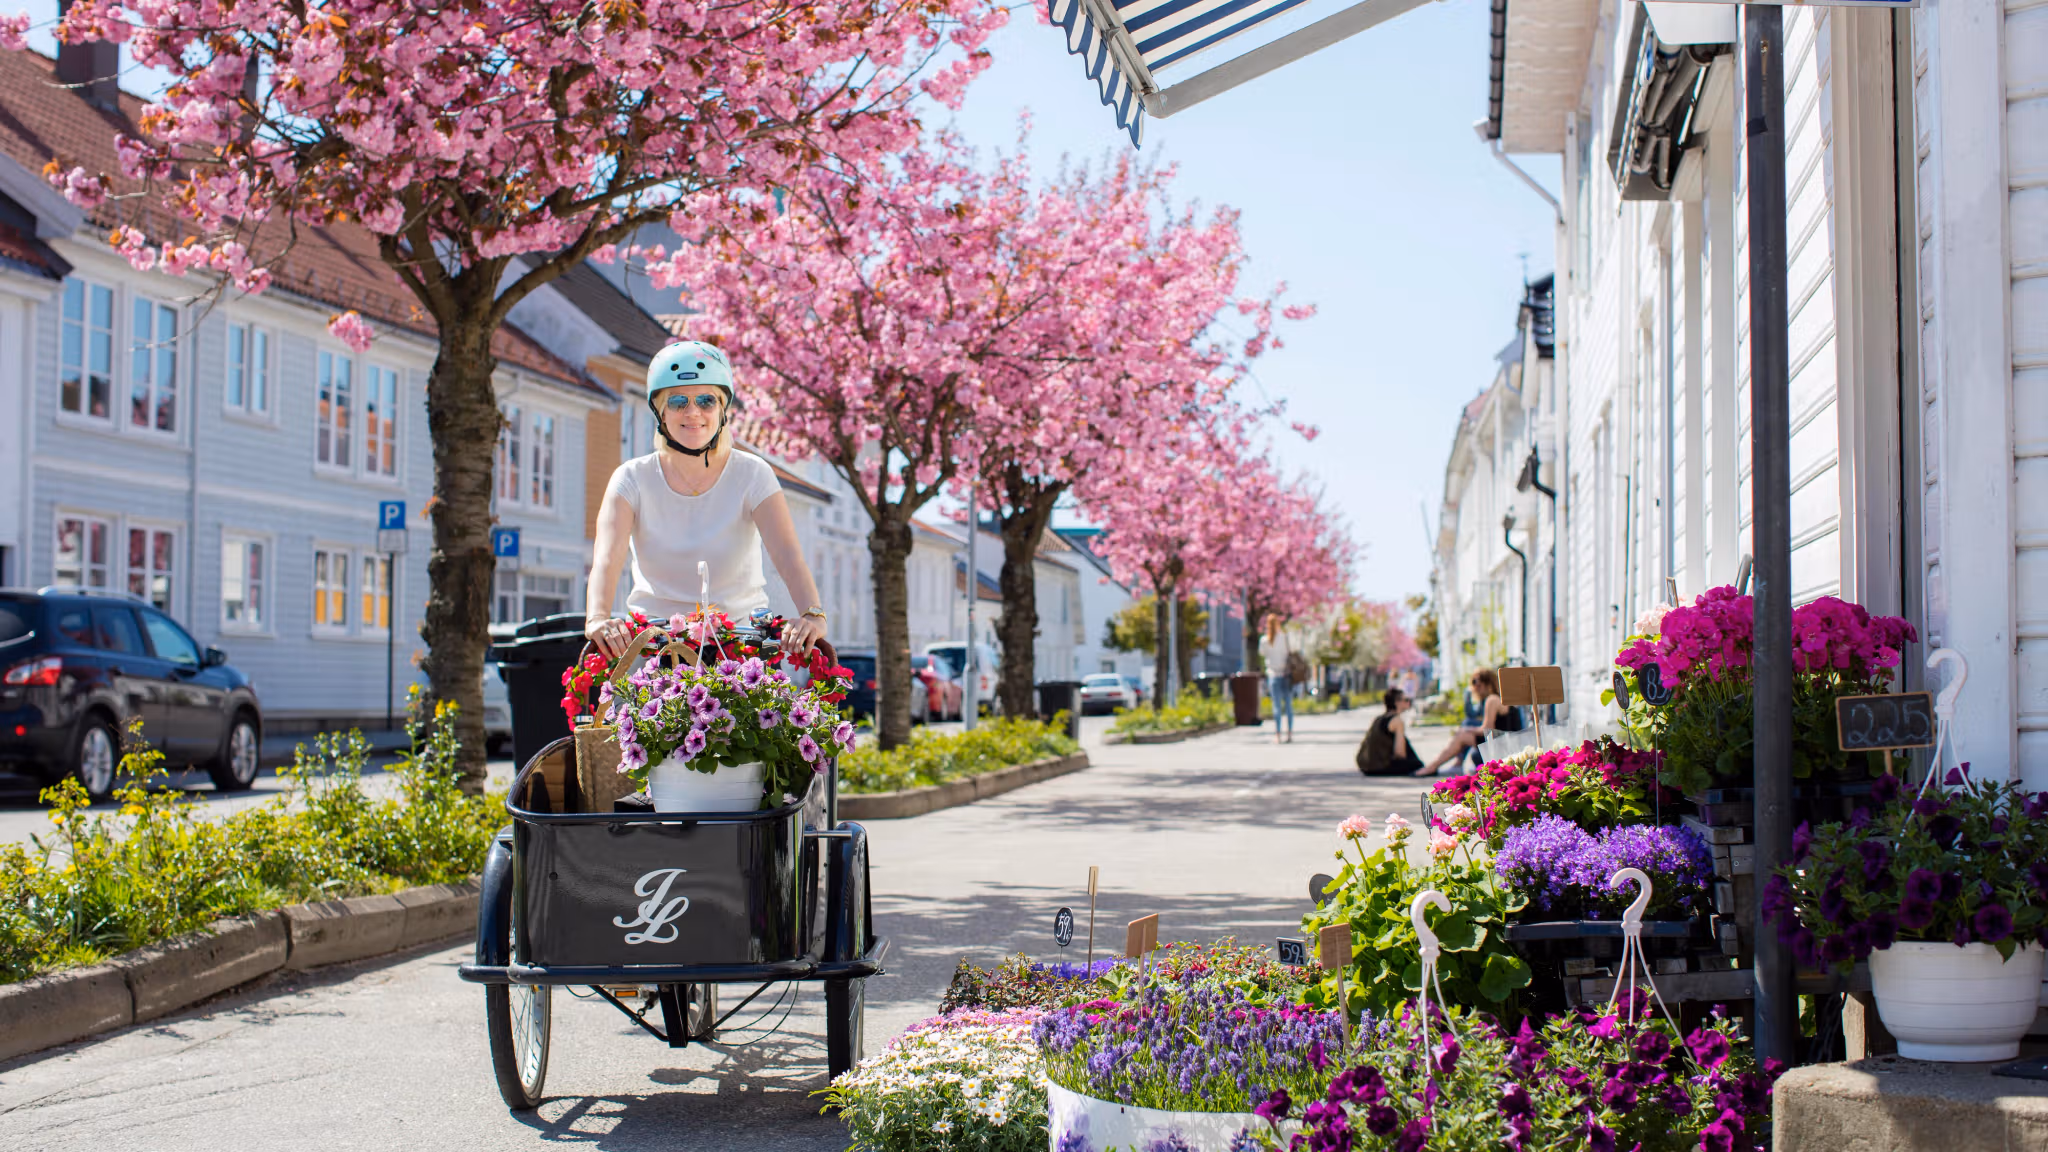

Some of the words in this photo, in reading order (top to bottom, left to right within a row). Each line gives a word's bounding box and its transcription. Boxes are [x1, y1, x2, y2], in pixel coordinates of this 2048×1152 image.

[385, 504, 399, 526] P
[500, 534, 512, 553] P
[1848, 699, 1930, 744] 225
